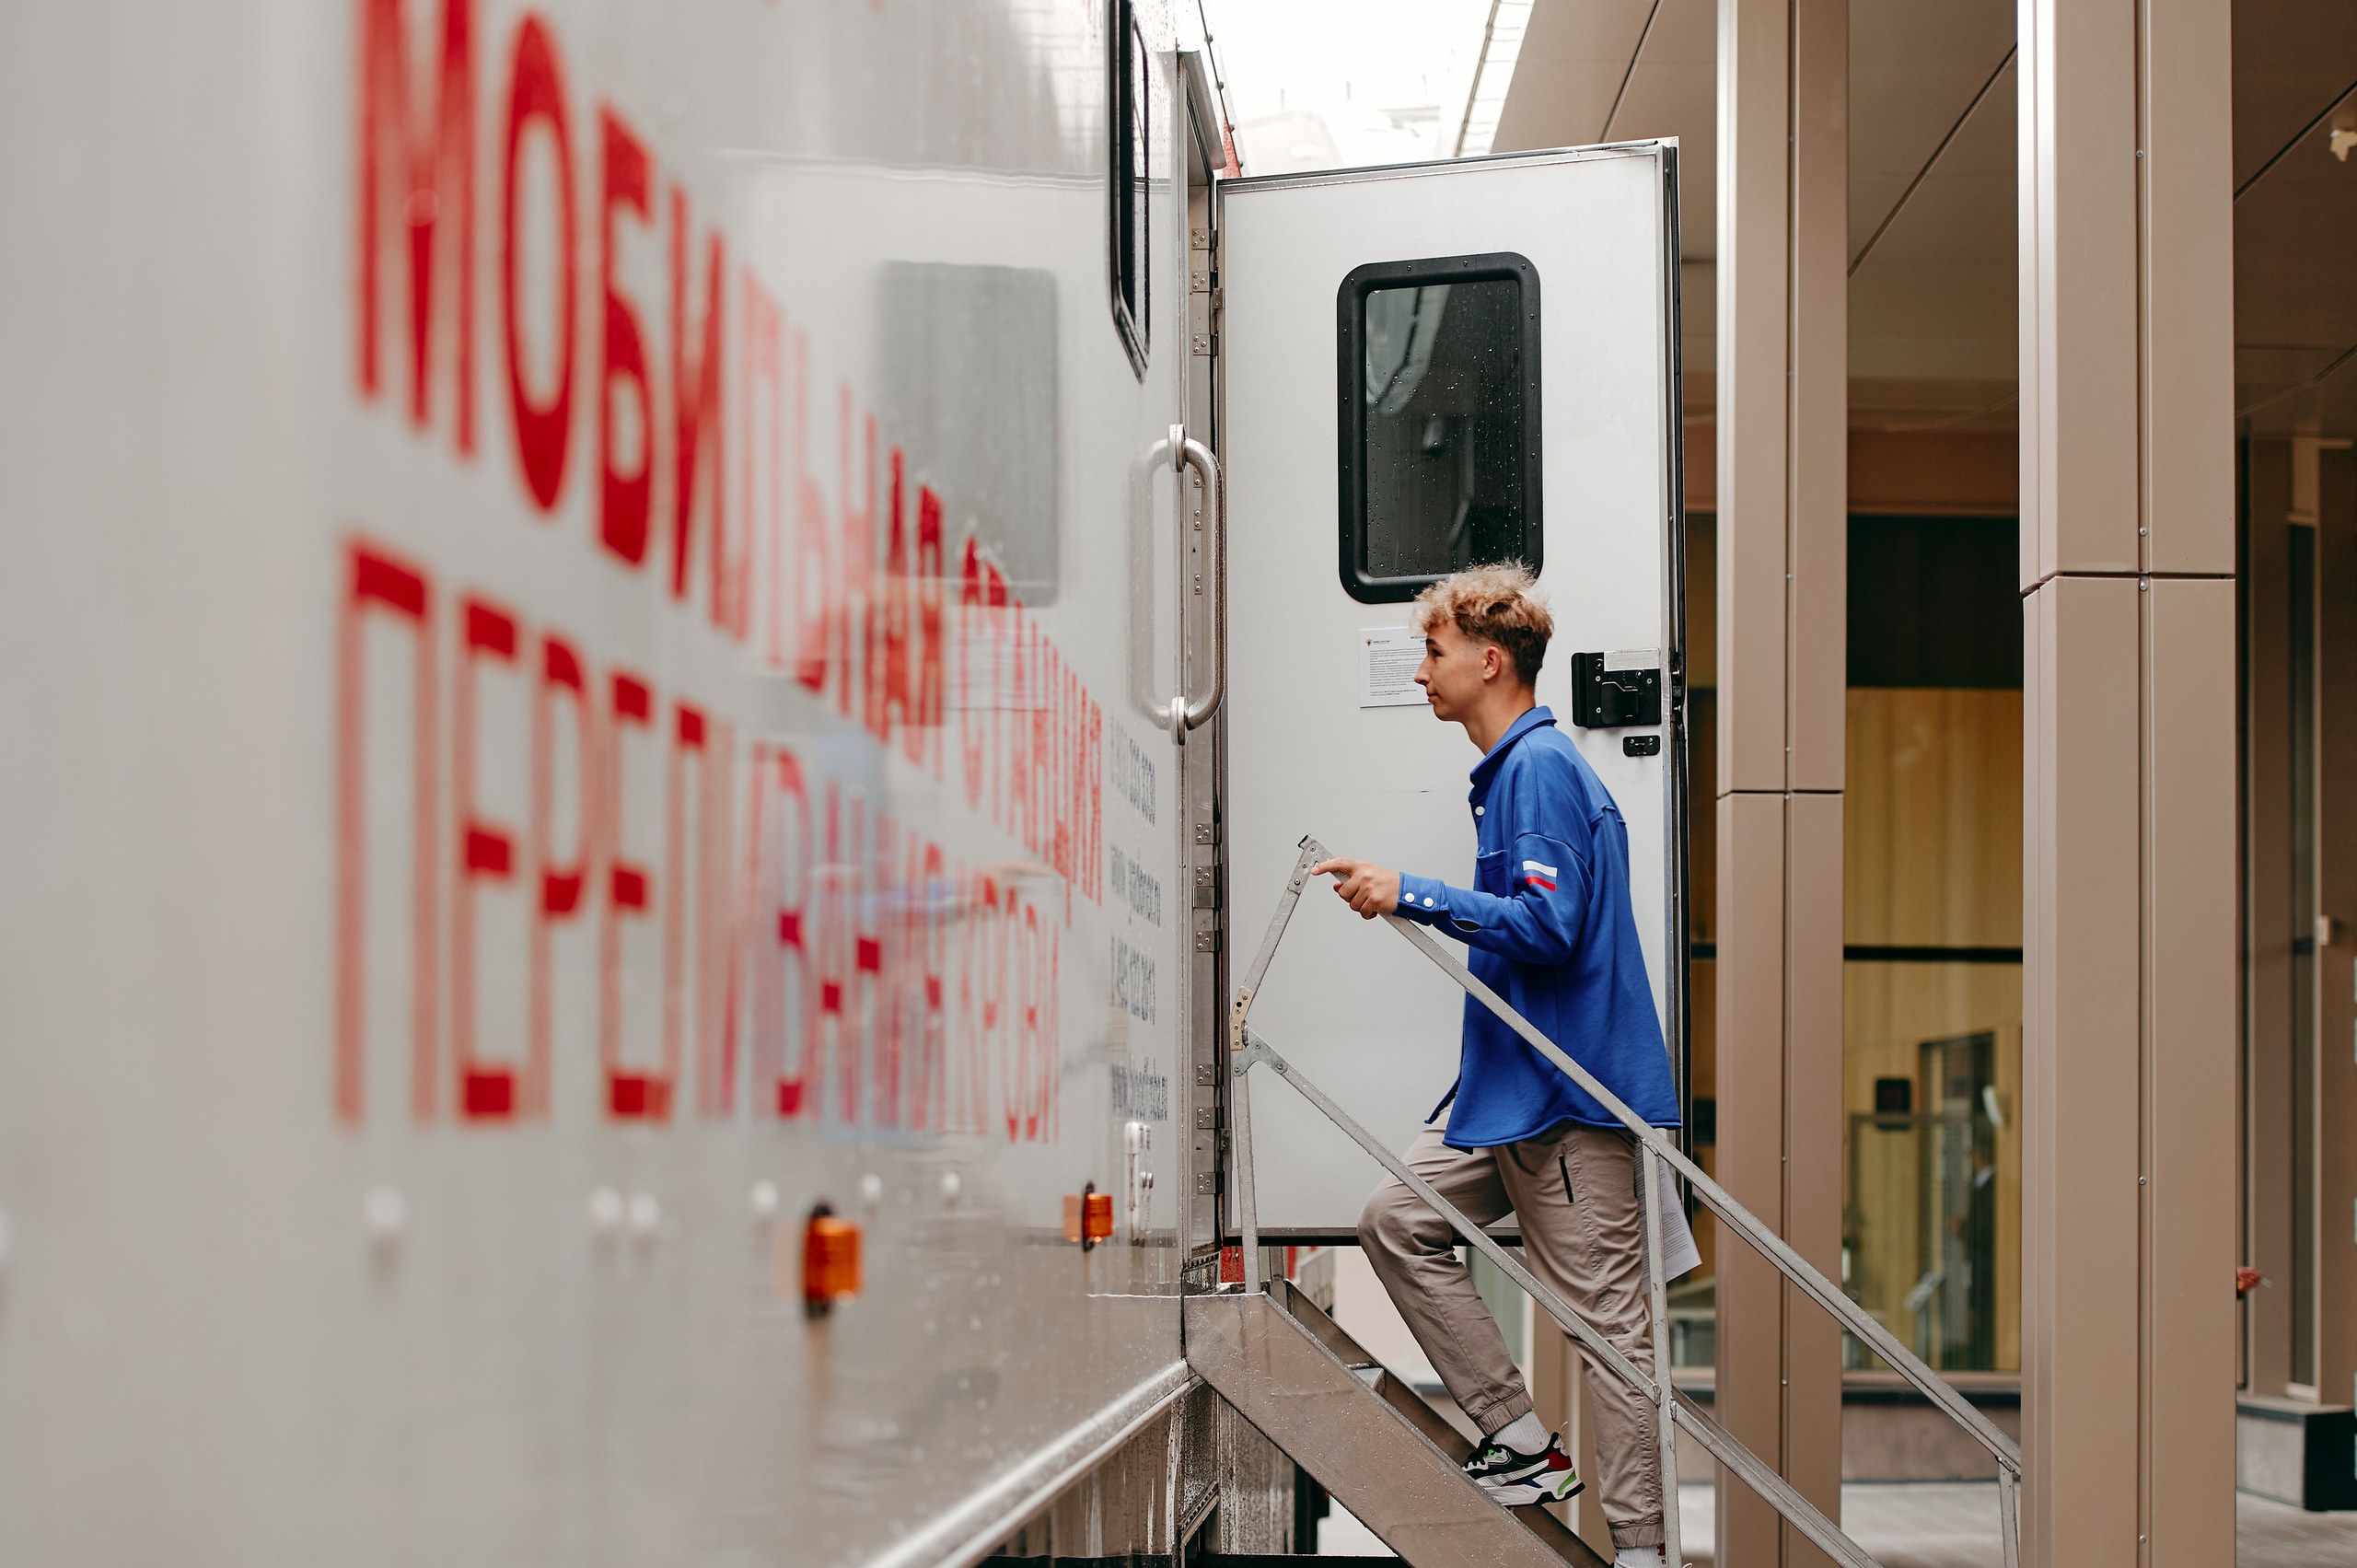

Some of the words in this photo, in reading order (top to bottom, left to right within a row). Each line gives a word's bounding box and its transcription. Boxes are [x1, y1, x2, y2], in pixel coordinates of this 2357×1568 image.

[336, 532, 946, 1131] ПЕРЕЛИВАНИЯ
[955, 861, 1060, 1144] КРОВИ
[354, 0, 944, 781] МОБИЛЬНАЯ
[960, 536, 1102, 927] СТАНЦИЯ
